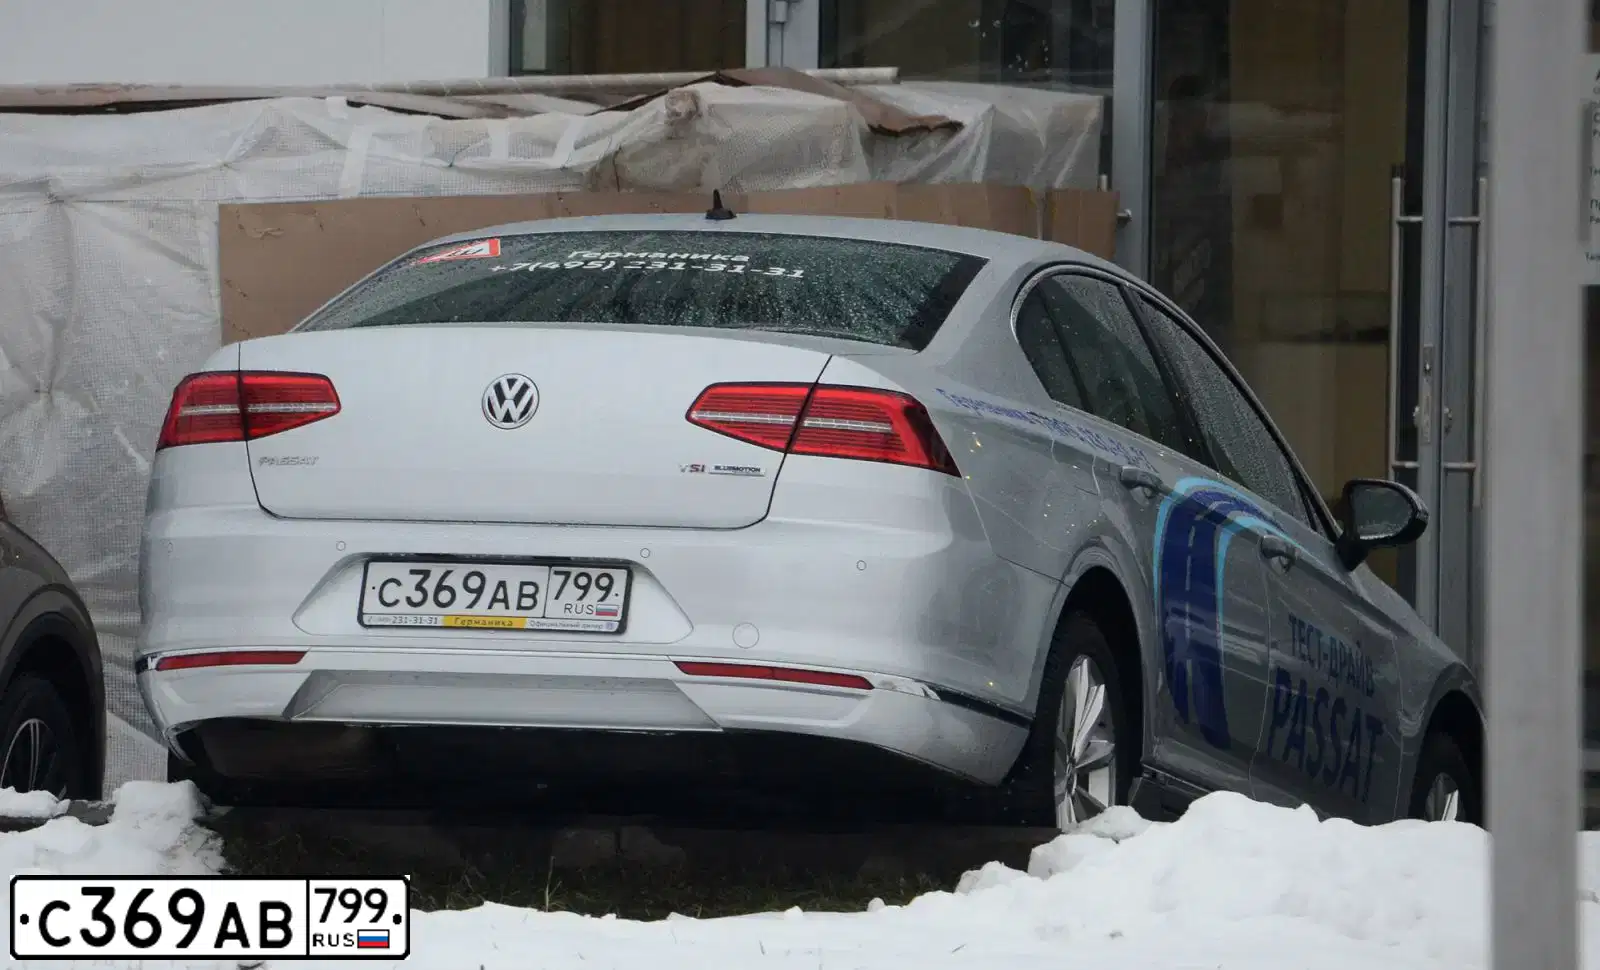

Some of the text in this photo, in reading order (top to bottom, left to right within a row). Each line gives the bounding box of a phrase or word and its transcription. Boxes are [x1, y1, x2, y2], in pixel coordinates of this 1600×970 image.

[567, 250, 752, 263] Германика
[553, 570, 615, 602] 799
[563, 603, 594, 615] RUS
[453, 616, 514, 628] Германика
[1268, 666, 1384, 805] PASSAT
